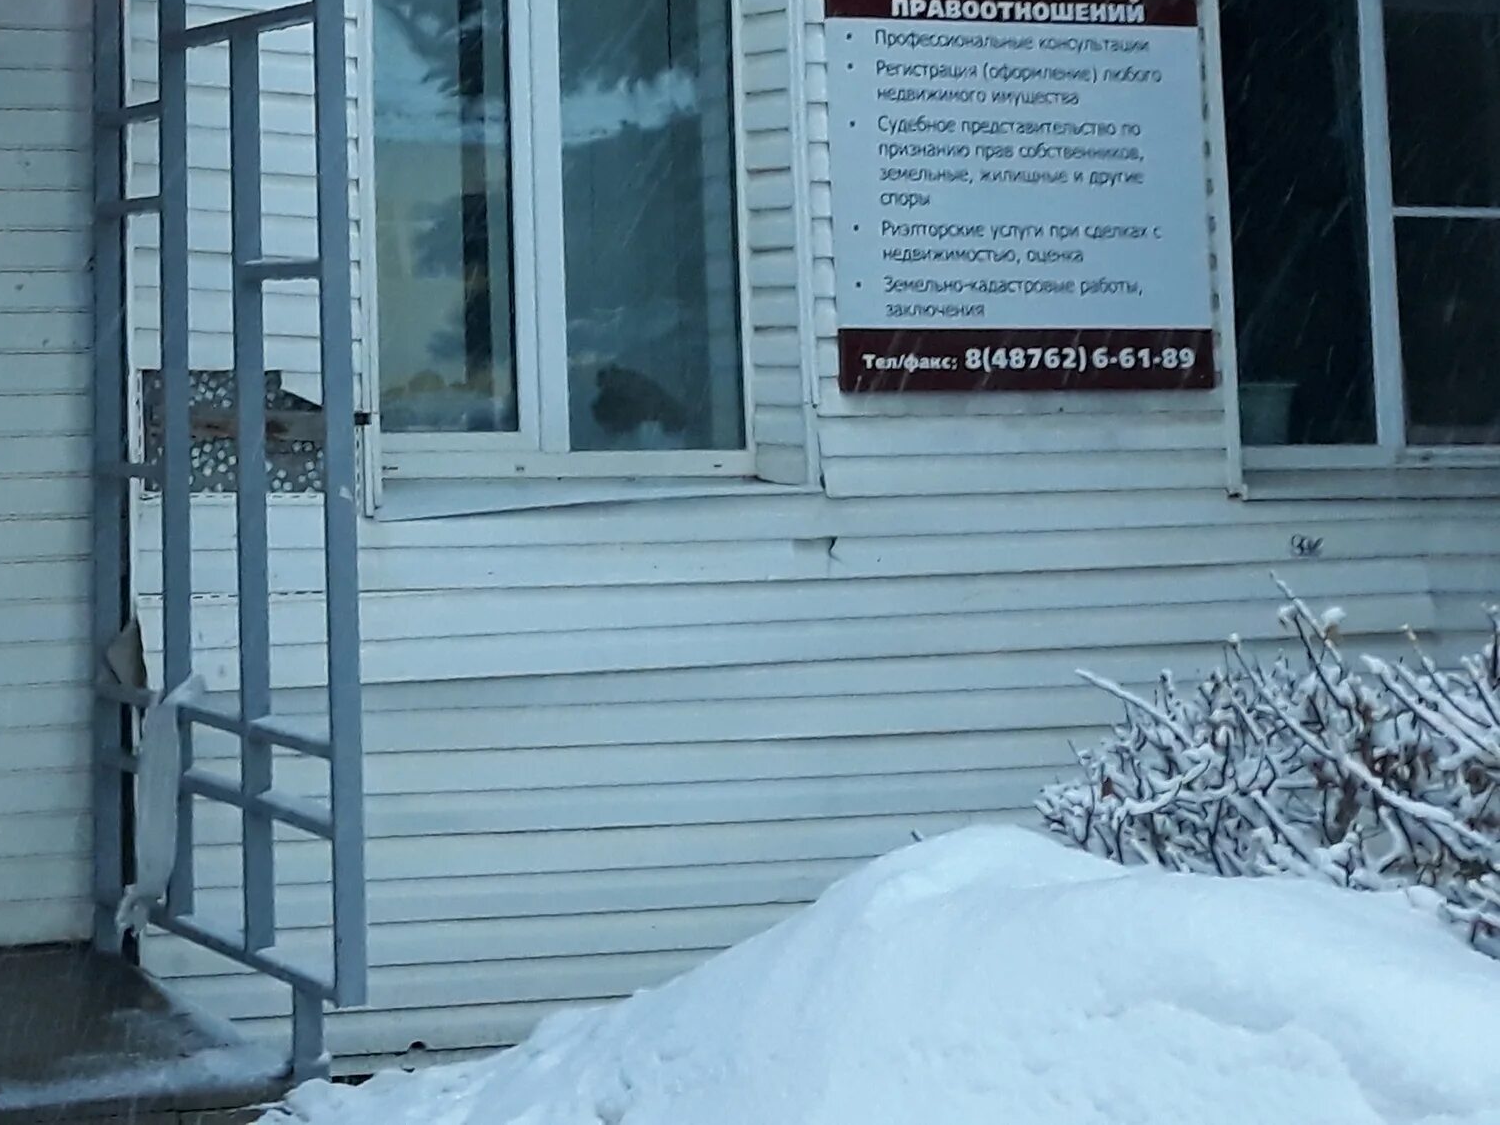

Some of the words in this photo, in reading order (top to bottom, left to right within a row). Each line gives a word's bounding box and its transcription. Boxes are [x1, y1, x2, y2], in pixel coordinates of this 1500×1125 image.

[875, 59, 978, 80] Регистрация
[877, 87, 986, 103] недвижимого
[991, 89, 1080, 106] имущества
[877, 114, 956, 135] Судебное
[878, 143, 971, 160] признанию
[974, 145, 1014, 161] прав
[1073, 170, 1084, 183] и
[880, 190, 931, 209] споры
[990, 225, 1044, 241] услуги
[1050, 225, 1079, 241] при
[882, 247, 1021, 265] недвижимостью,
[964, 346, 1087, 373] 8(48762)
[1092, 346, 1196, 369] 6-61-89
